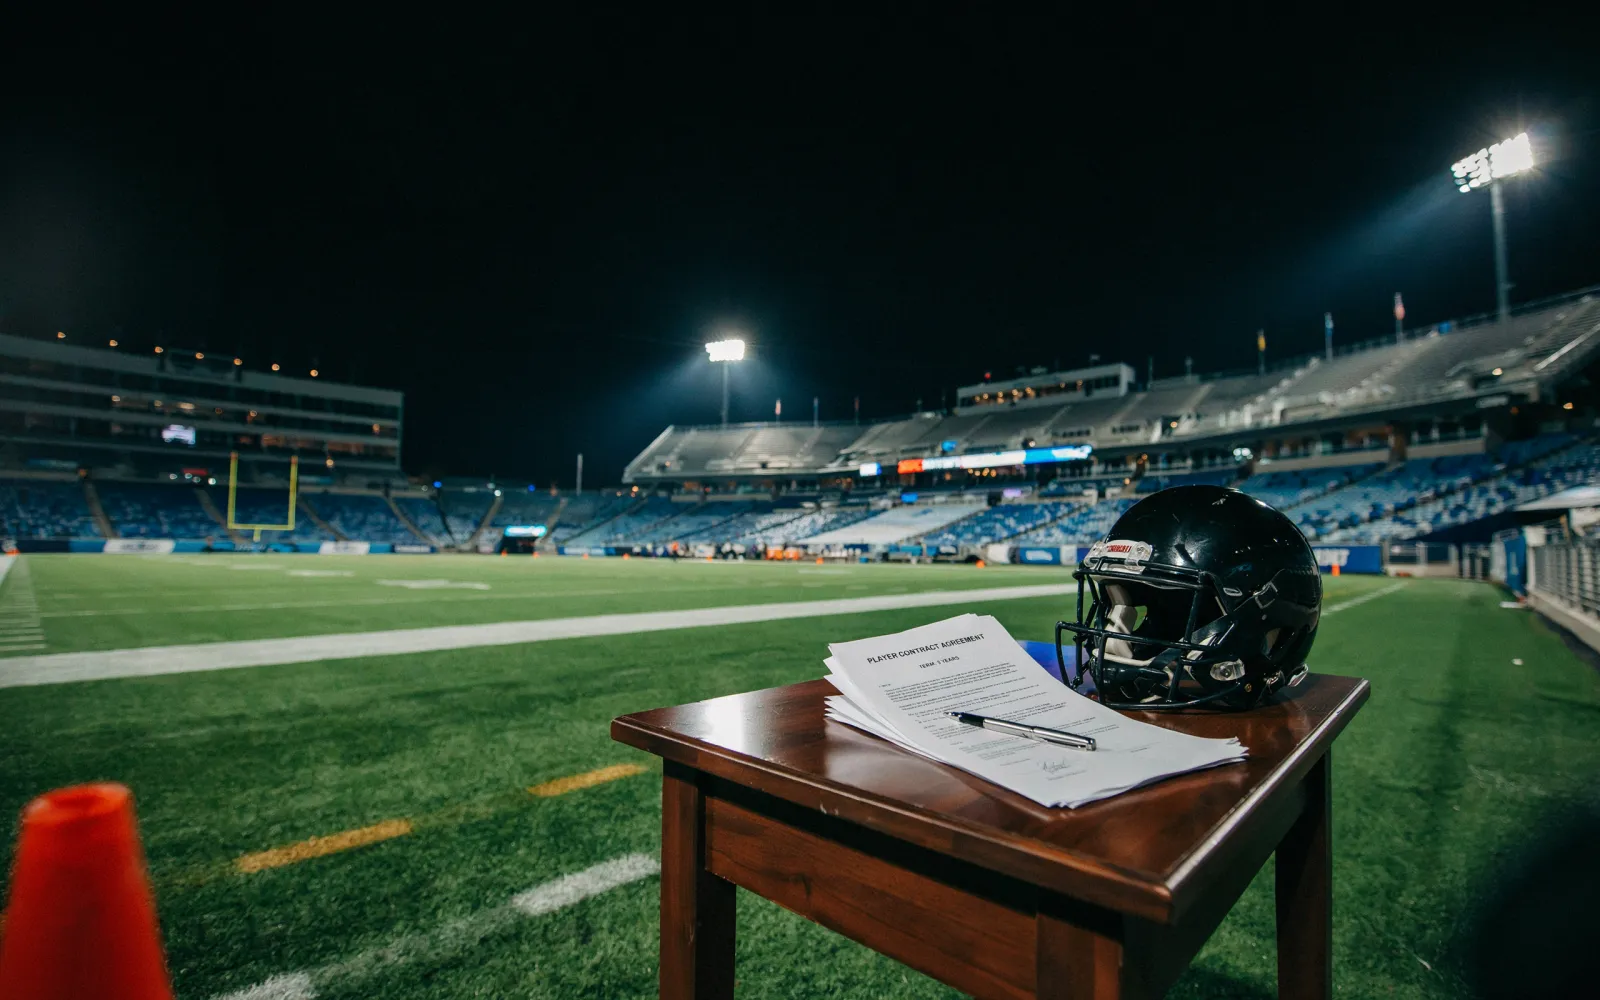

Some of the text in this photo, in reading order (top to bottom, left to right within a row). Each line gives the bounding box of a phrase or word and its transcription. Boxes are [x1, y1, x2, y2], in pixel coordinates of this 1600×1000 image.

[867, 633, 985, 664] PLAYER CONTRACT AGREEMENT
